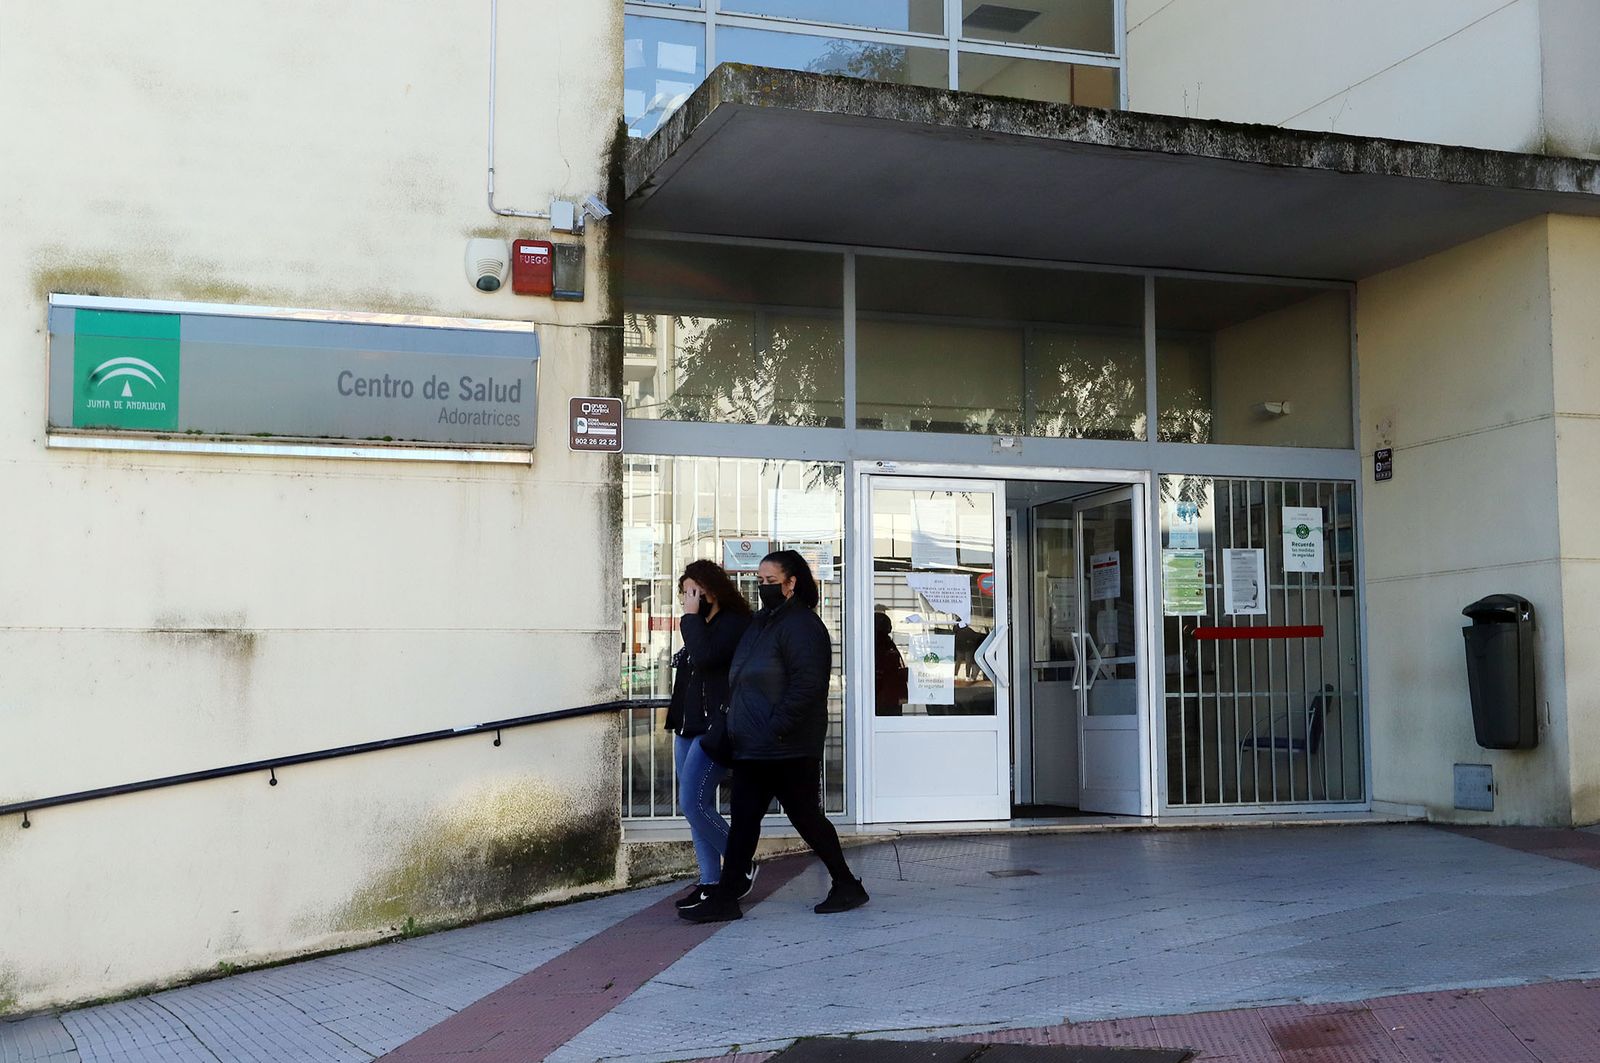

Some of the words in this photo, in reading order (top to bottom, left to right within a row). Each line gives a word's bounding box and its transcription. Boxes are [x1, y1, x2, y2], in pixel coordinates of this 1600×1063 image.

[337, 370, 414, 399] Centro
[422, 374, 450, 400] de
[458, 375, 522, 403] Salud
[86, 399, 111, 409] JUNTA
[113, 400, 123, 410] DE
[126, 401, 167, 411] ANDALUCIA
[437, 406, 521, 427] Adoratrices
[599, 438, 608, 446] 22
[608, 438, 617, 446] 22
